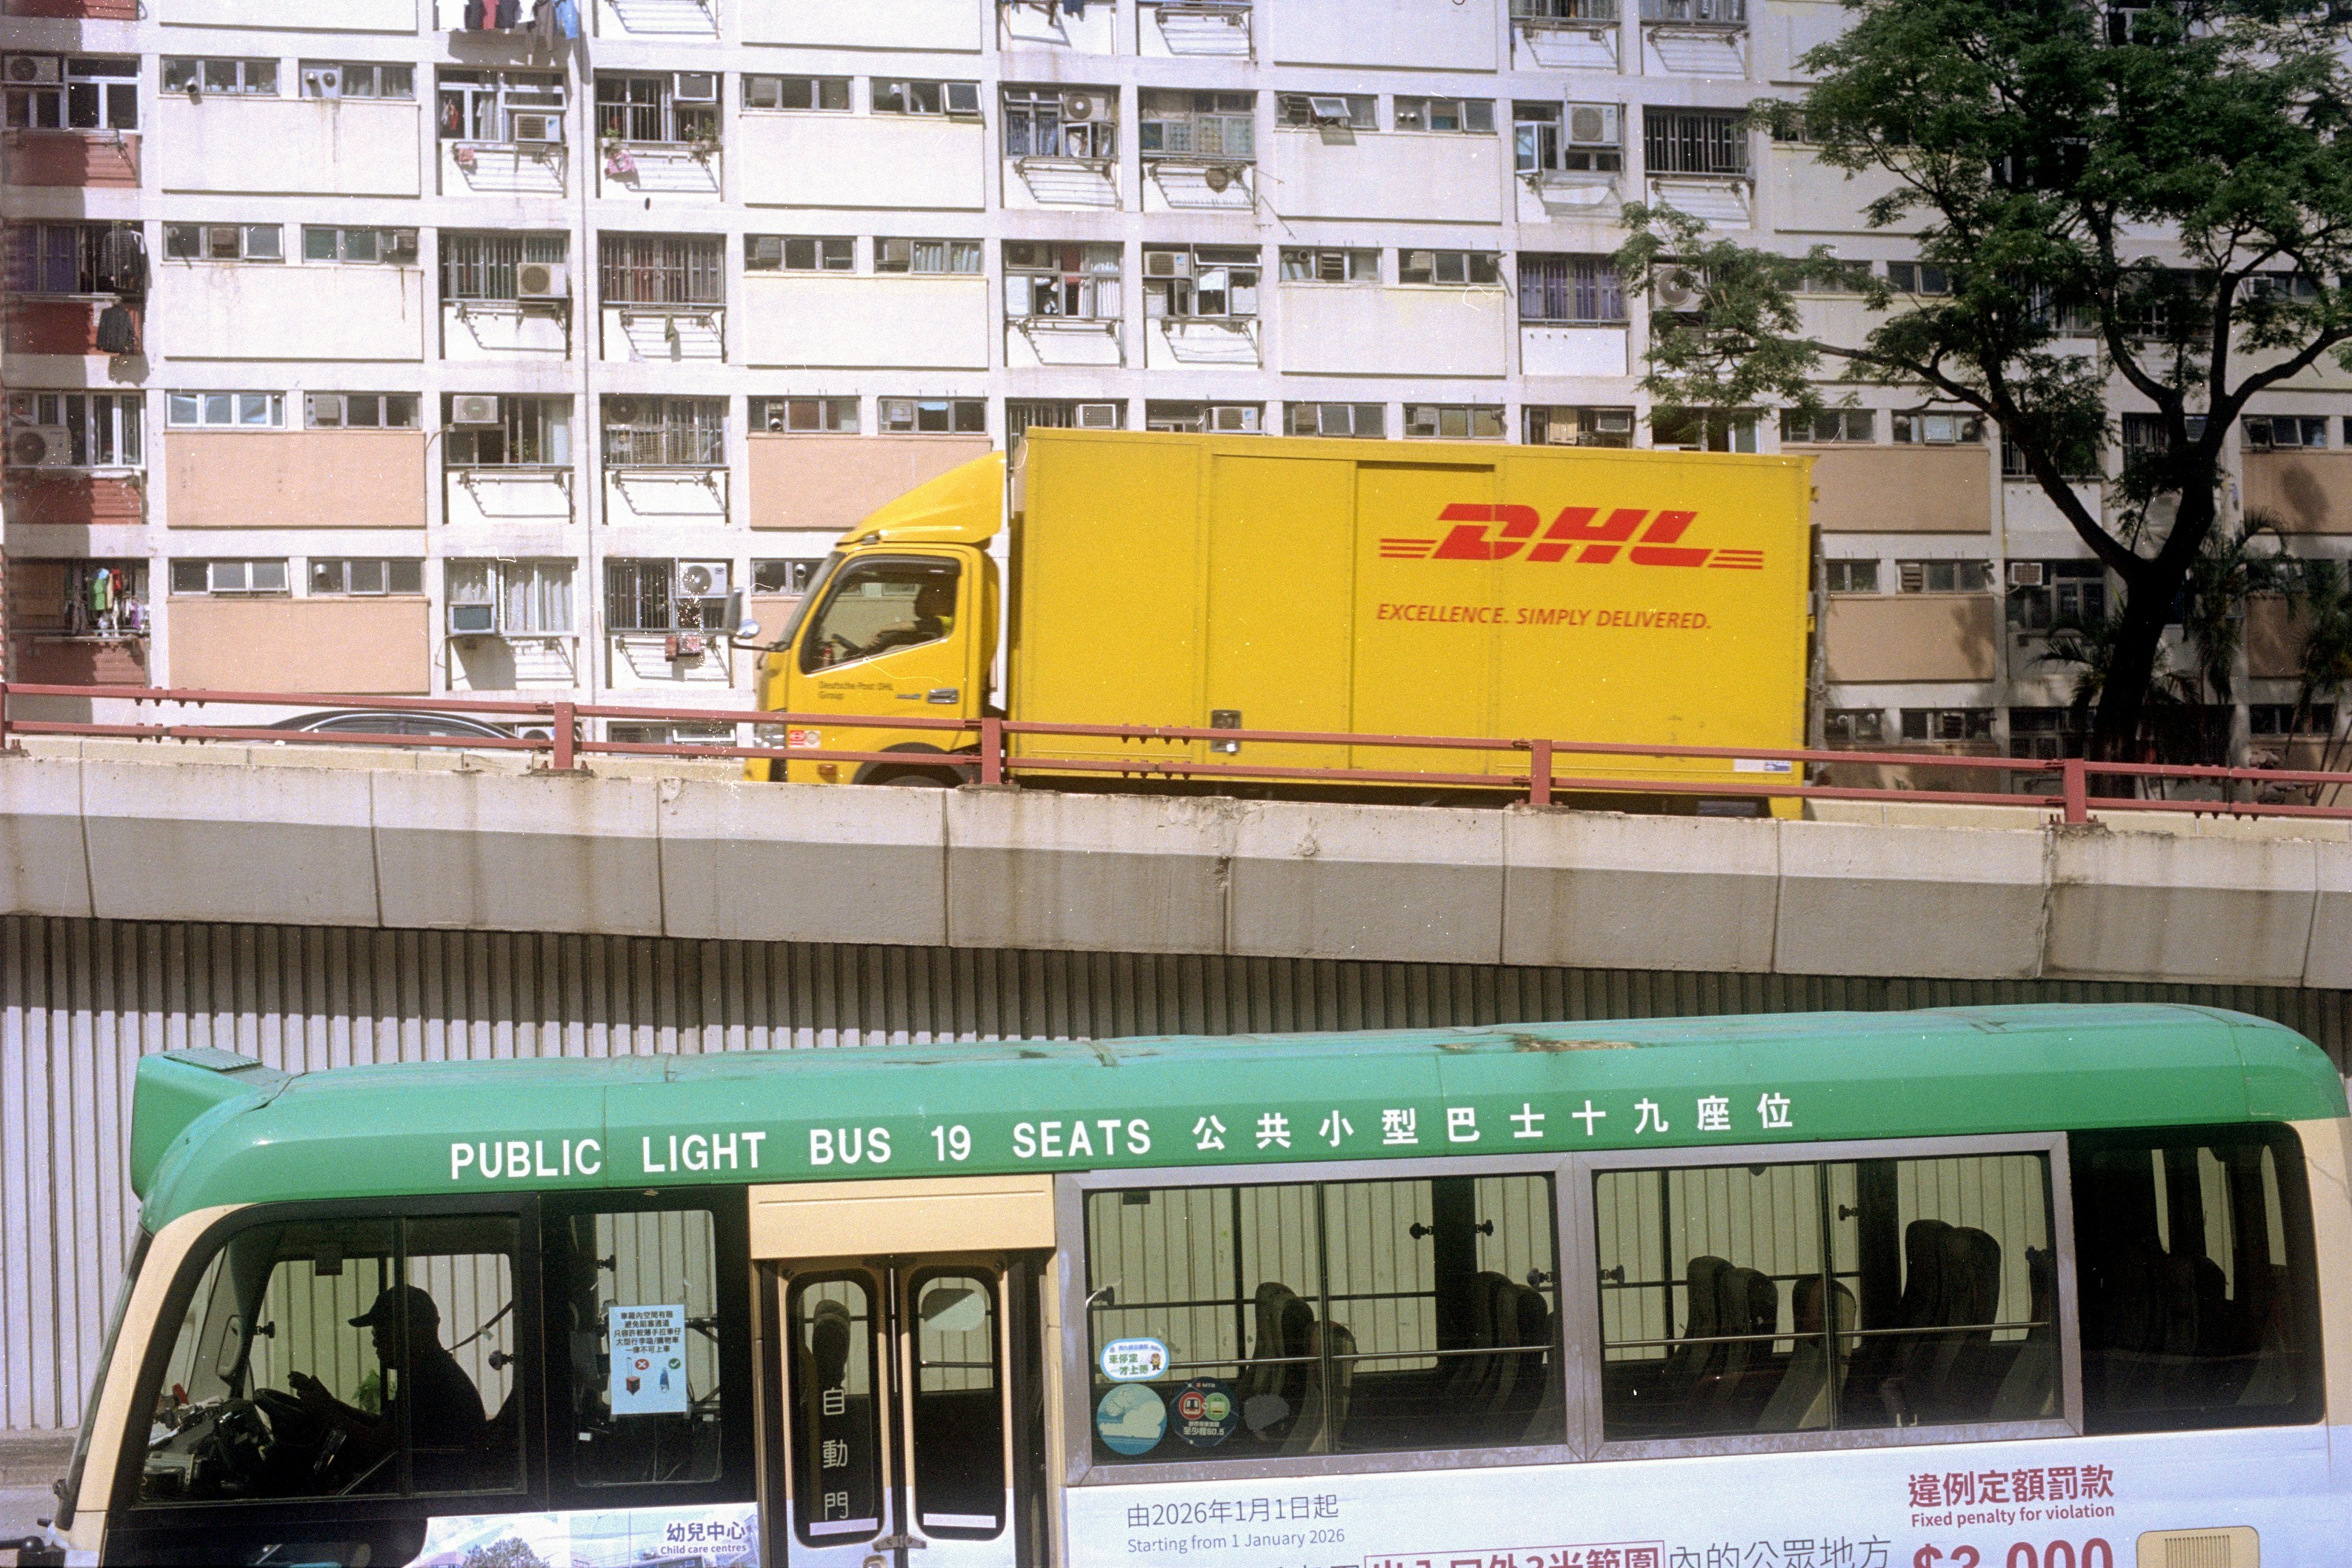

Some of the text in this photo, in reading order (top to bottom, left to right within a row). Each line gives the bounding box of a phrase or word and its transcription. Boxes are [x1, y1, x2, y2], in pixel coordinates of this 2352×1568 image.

[1431, 503, 1713, 567] DHL
[1376, 604, 1712, 630] EXCELLENCE. SIMPLY DELIVERED.
[819, 681, 894, 691] Deutsche Post DHL
[819, 691, 844, 700] Group
[1191, 1092, 1794, 1151] 公共小型巴士十九座位
[450, 1118, 1151, 1180] PUBLIC LIGHT BUS 19 SEATS
[625, 1346, 670, 1354] 一律不可上車
[822, 1387, 849, 1521] 自動門
[1908, 1464, 2115, 1508] 違例定額罰款
[1127, 1493, 1339, 1529] 由2026年1月1日起
[1910, 1504, 2115, 1529] Fixed penalty for violation
[666, 1521, 746, 1543] 幼兒中心
[1127, 1528, 1345, 1554] Starting from 1 January 2026
[660, 1543, 747, 1555] Child care centres
